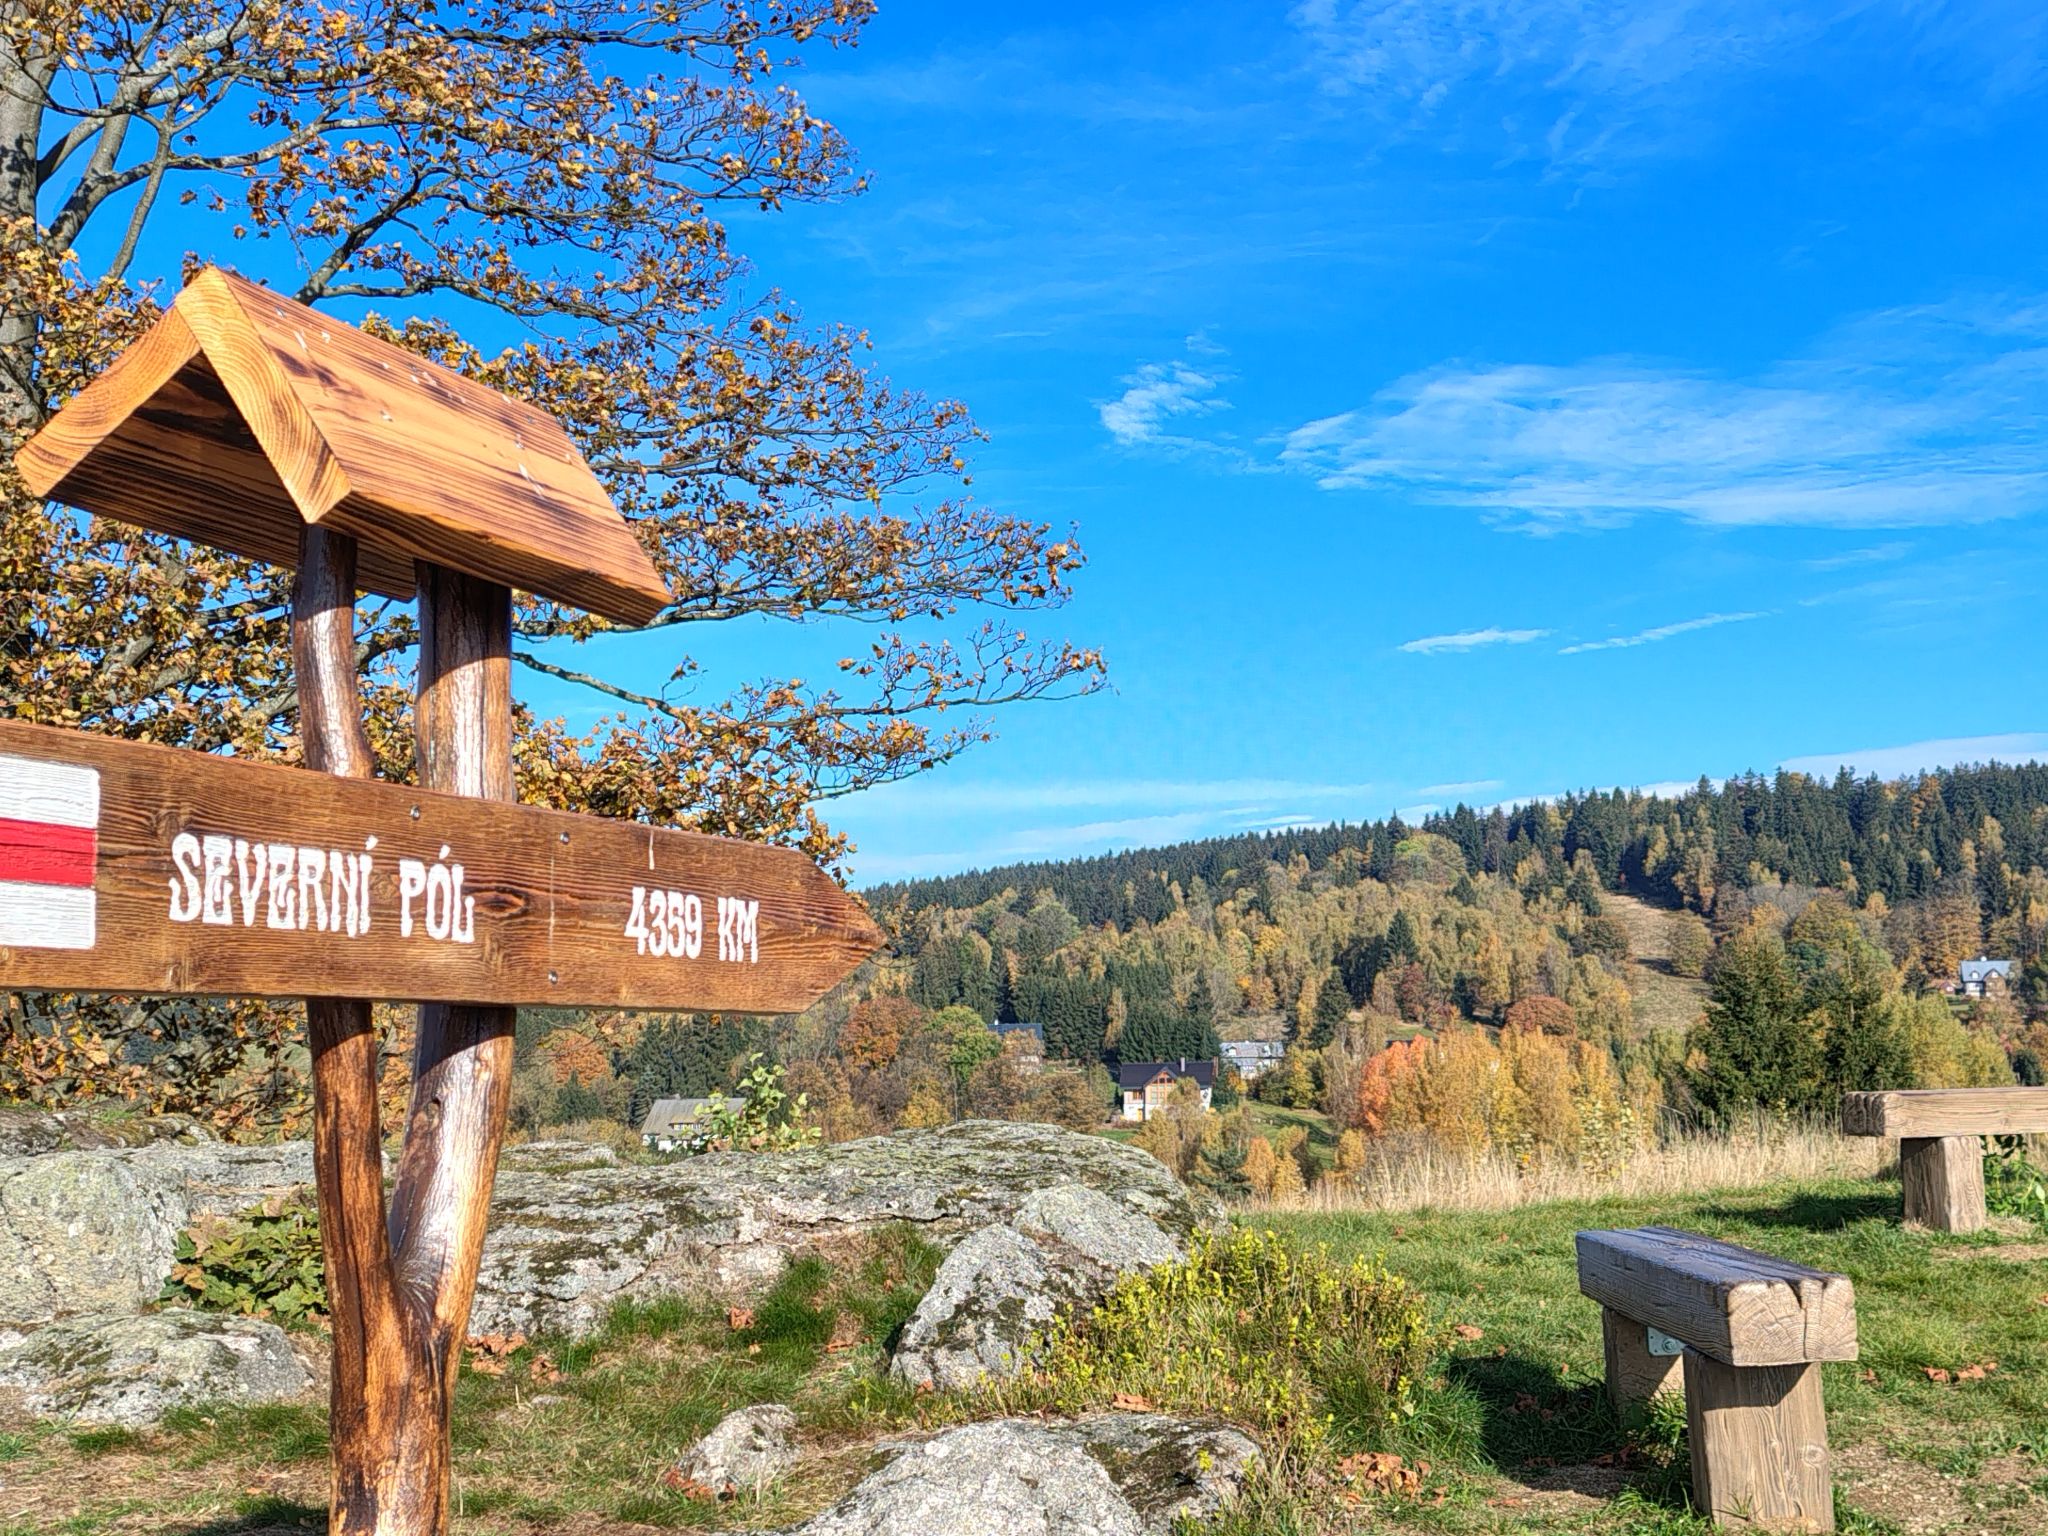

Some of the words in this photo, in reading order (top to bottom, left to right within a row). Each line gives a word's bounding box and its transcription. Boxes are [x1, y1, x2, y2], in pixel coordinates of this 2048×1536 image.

[167, 832, 379, 939] SEVERNÍ
[397, 843, 476, 944] PÓL
[624, 886, 704, 960] 4359
[717, 896, 760, 964] KM
